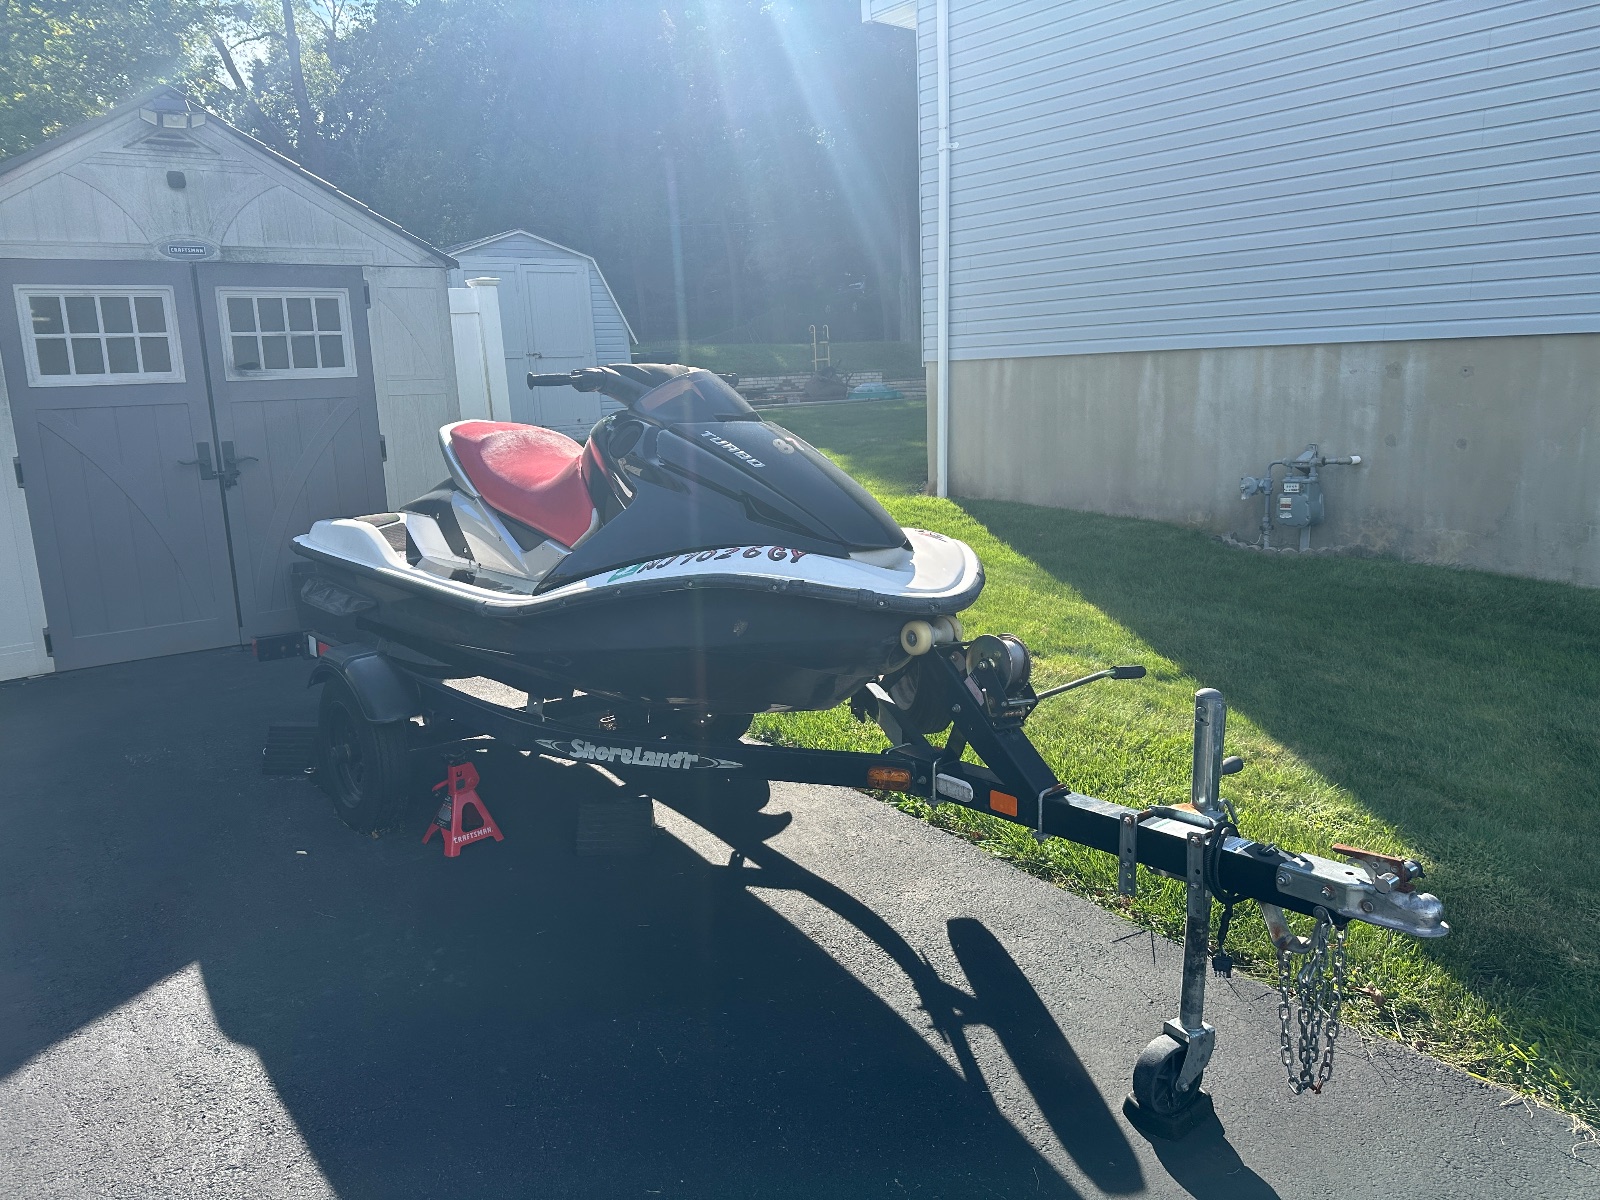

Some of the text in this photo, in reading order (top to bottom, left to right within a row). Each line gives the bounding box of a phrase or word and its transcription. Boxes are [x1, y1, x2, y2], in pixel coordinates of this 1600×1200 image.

[701, 430, 766, 468] TURBO
[637, 555, 679, 574] NJ
[767, 545, 806, 564] GY
[453, 826, 493, 844] CRAFTSMAN
